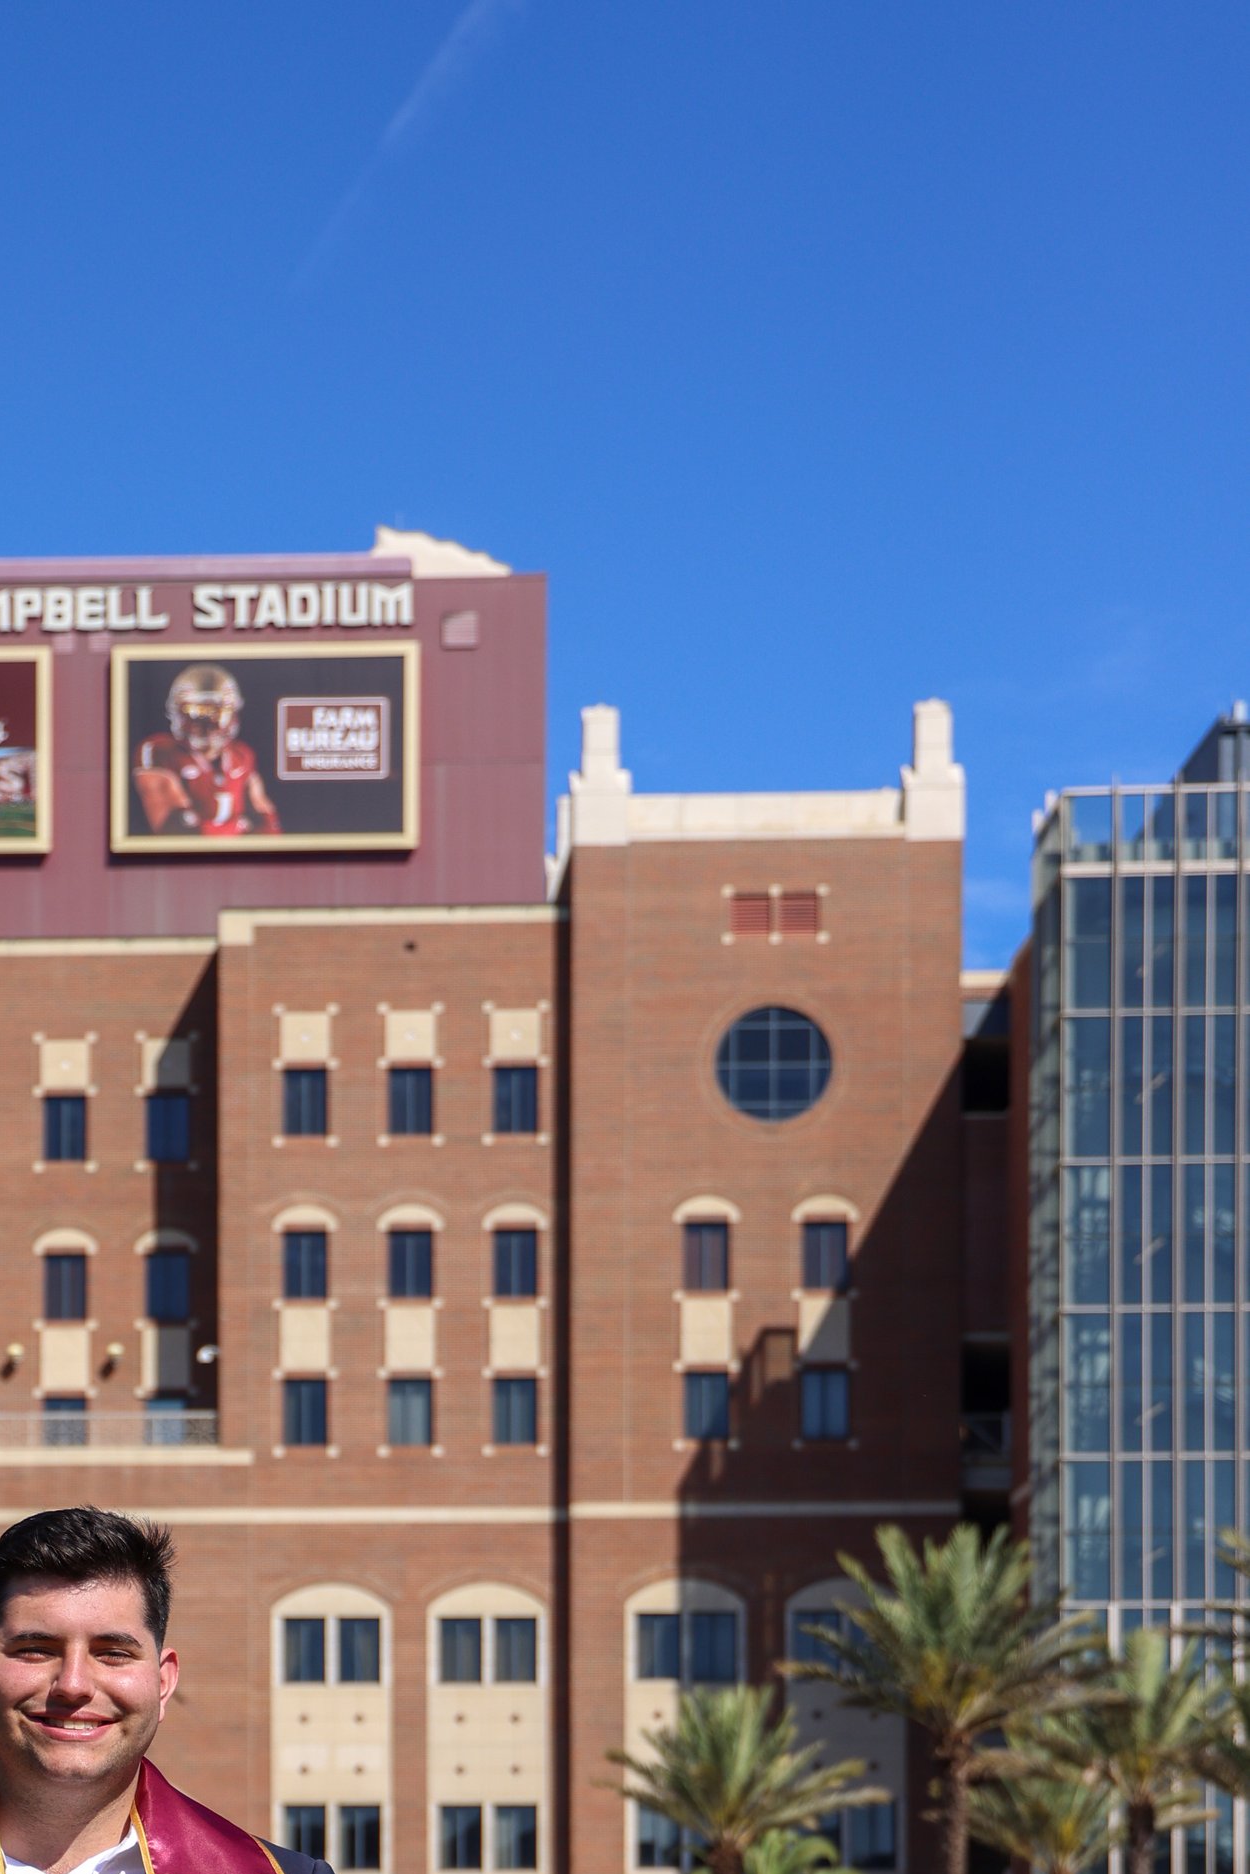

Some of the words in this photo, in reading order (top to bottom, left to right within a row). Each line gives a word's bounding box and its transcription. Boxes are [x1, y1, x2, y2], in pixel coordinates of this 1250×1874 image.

[193, 581, 415, 629] STADIUM
[312, 706, 378, 728] FARM
[286, 727, 379, 751] BUREAU
[301, 755, 378, 770] INSURANCE
